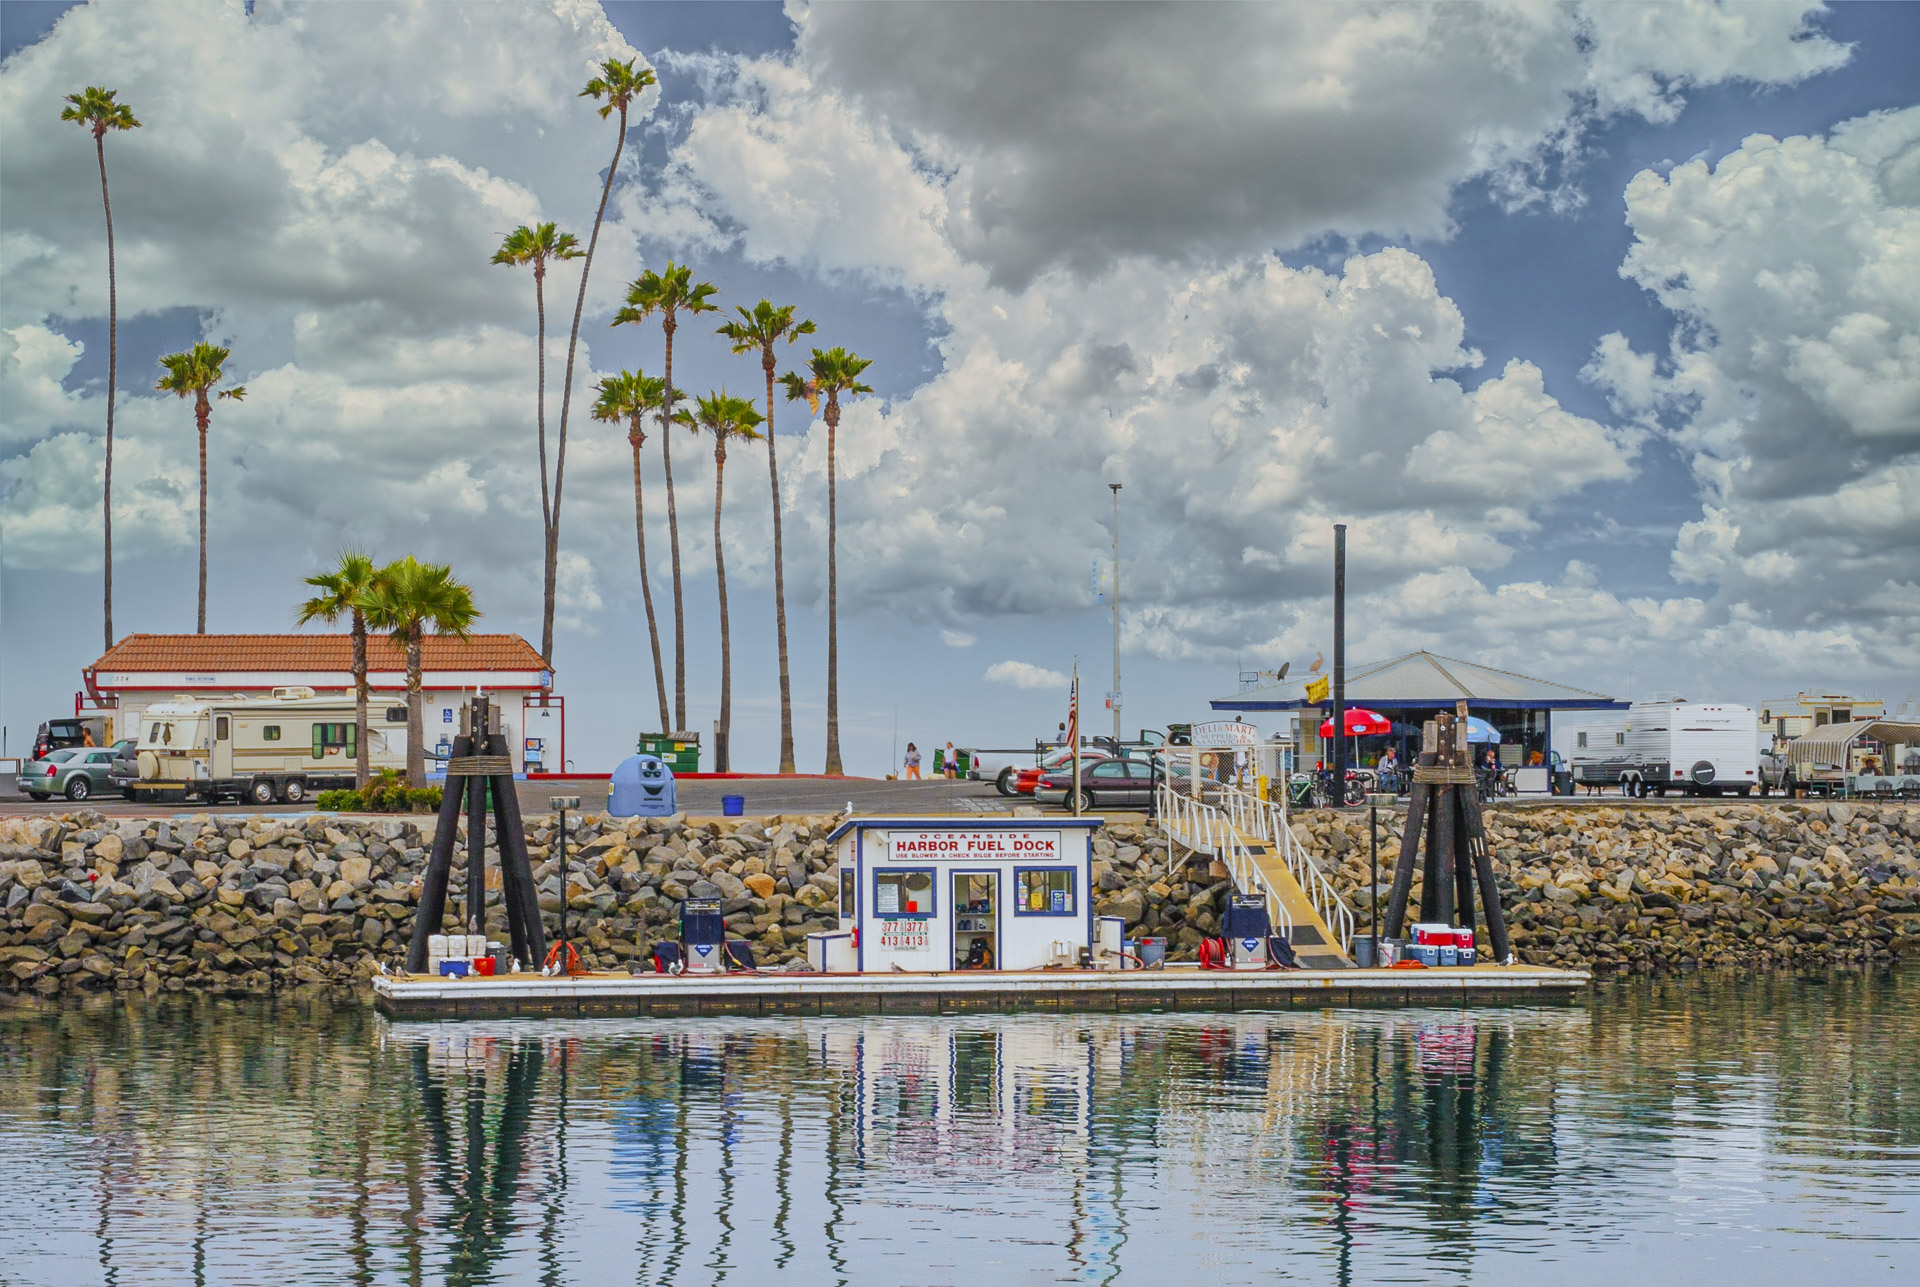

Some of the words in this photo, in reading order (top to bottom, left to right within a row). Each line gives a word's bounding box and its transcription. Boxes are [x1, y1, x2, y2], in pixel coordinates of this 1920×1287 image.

[1194, 724, 1216, 735] DELI
[1225, 723, 1254, 735] MART
[896, 840, 959, 851] HARBOR
[967, 840, 1005, 851] FUEL
[1013, 840, 1055, 851] DOCK
